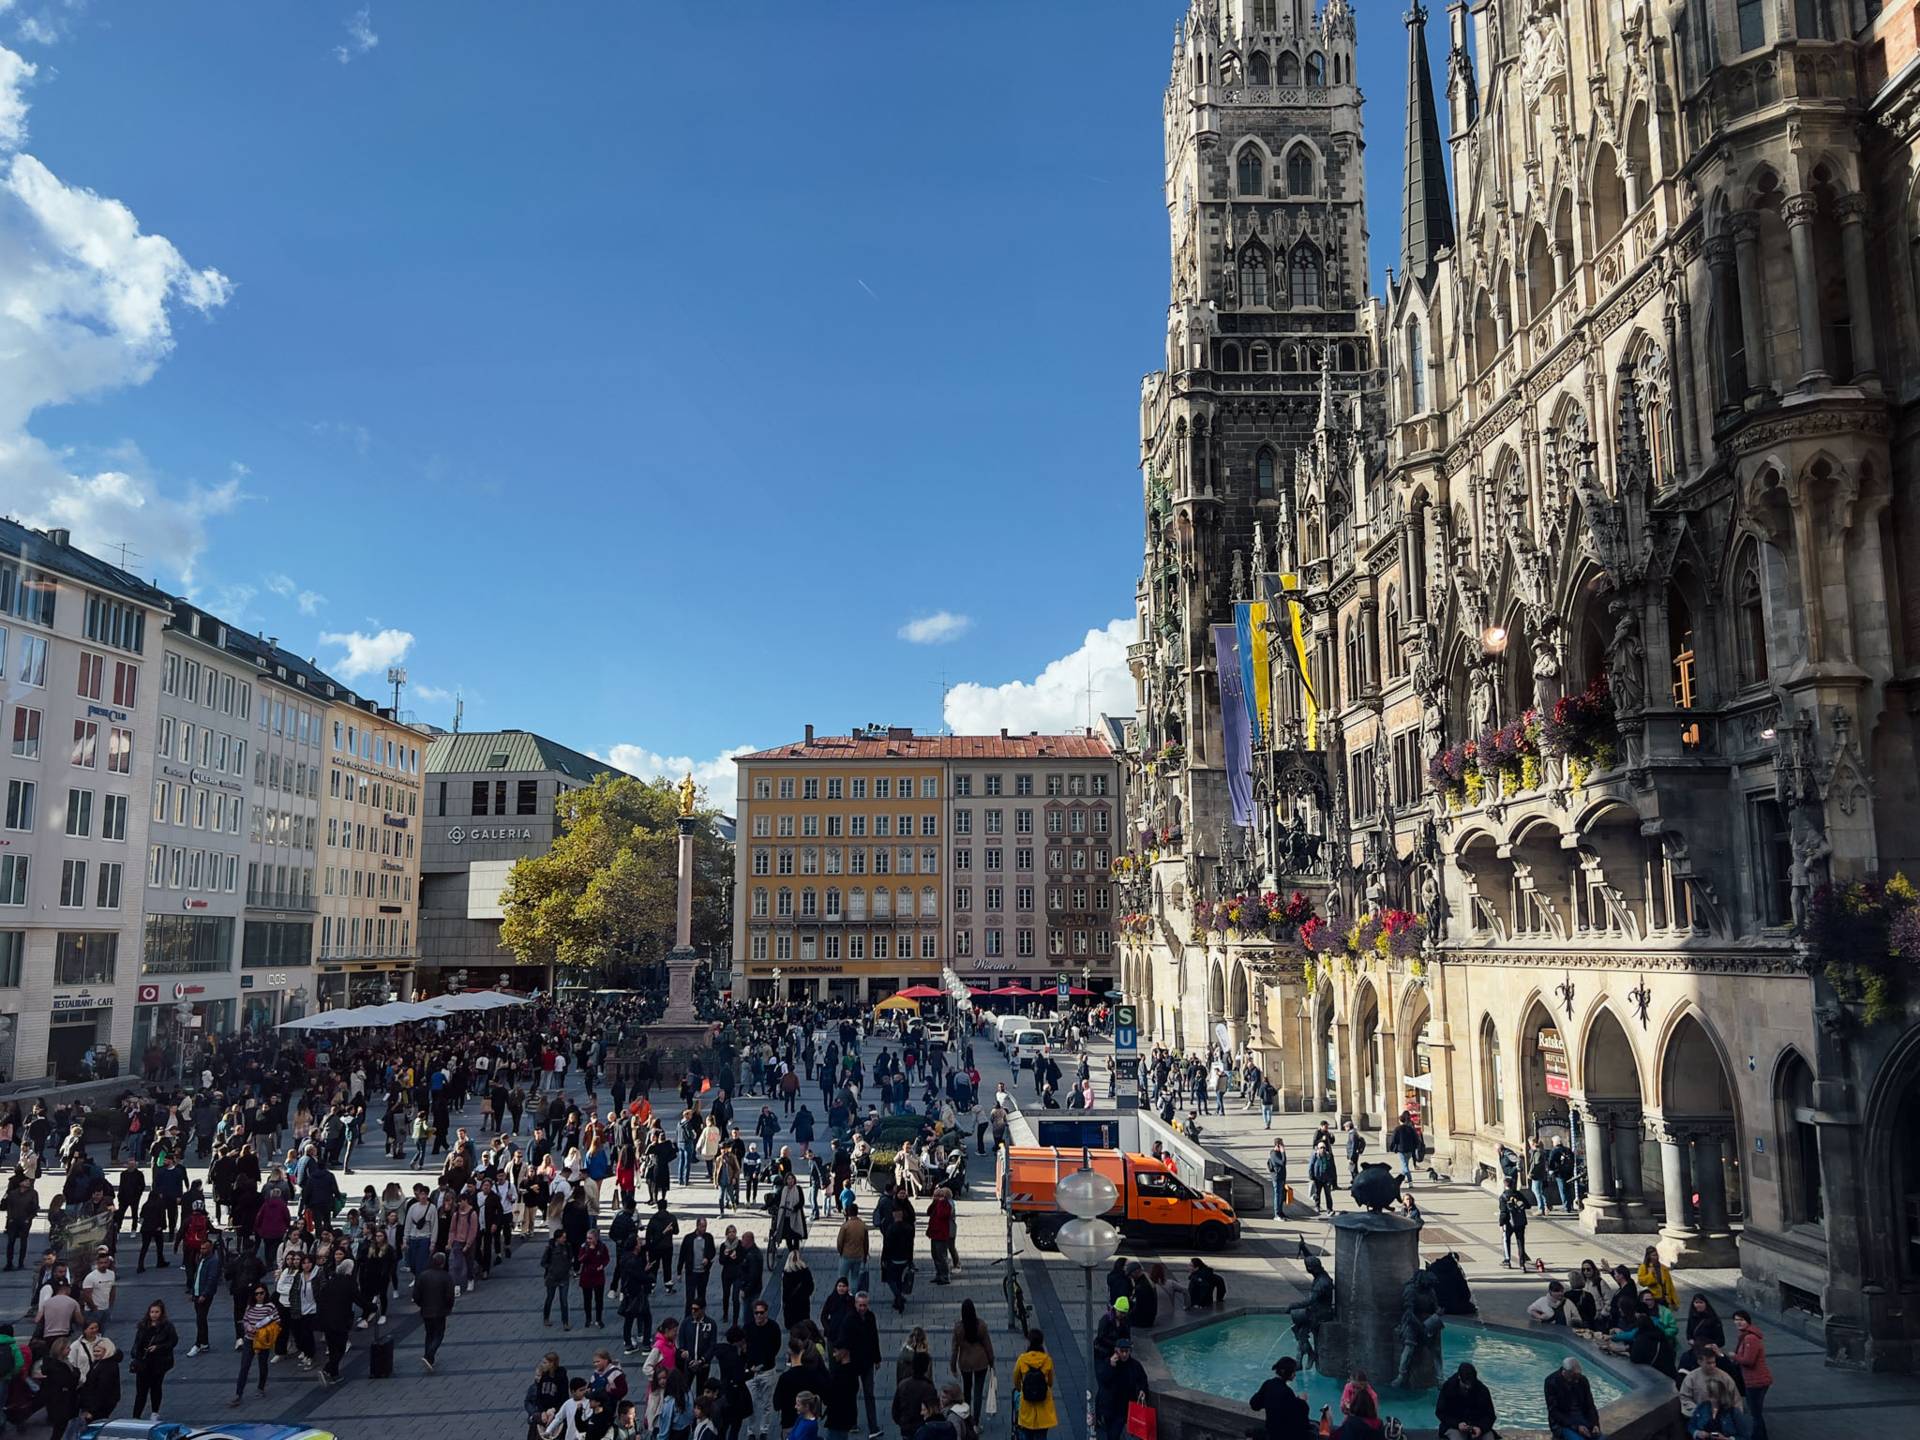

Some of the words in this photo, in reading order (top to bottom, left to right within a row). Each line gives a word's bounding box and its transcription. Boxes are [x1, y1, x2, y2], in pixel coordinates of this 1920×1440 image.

[471, 829, 531, 839] GALERIA
[266, 973, 287, 986] IQOS
[1060, 974, 1067, 984] S
[1060, 984, 1066, 994] U
[53, 1000, 92, 1008] RESTAURANT
[1119, 1008, 1132, 1025] S
[1120, 1029, 1132, 1046] U
